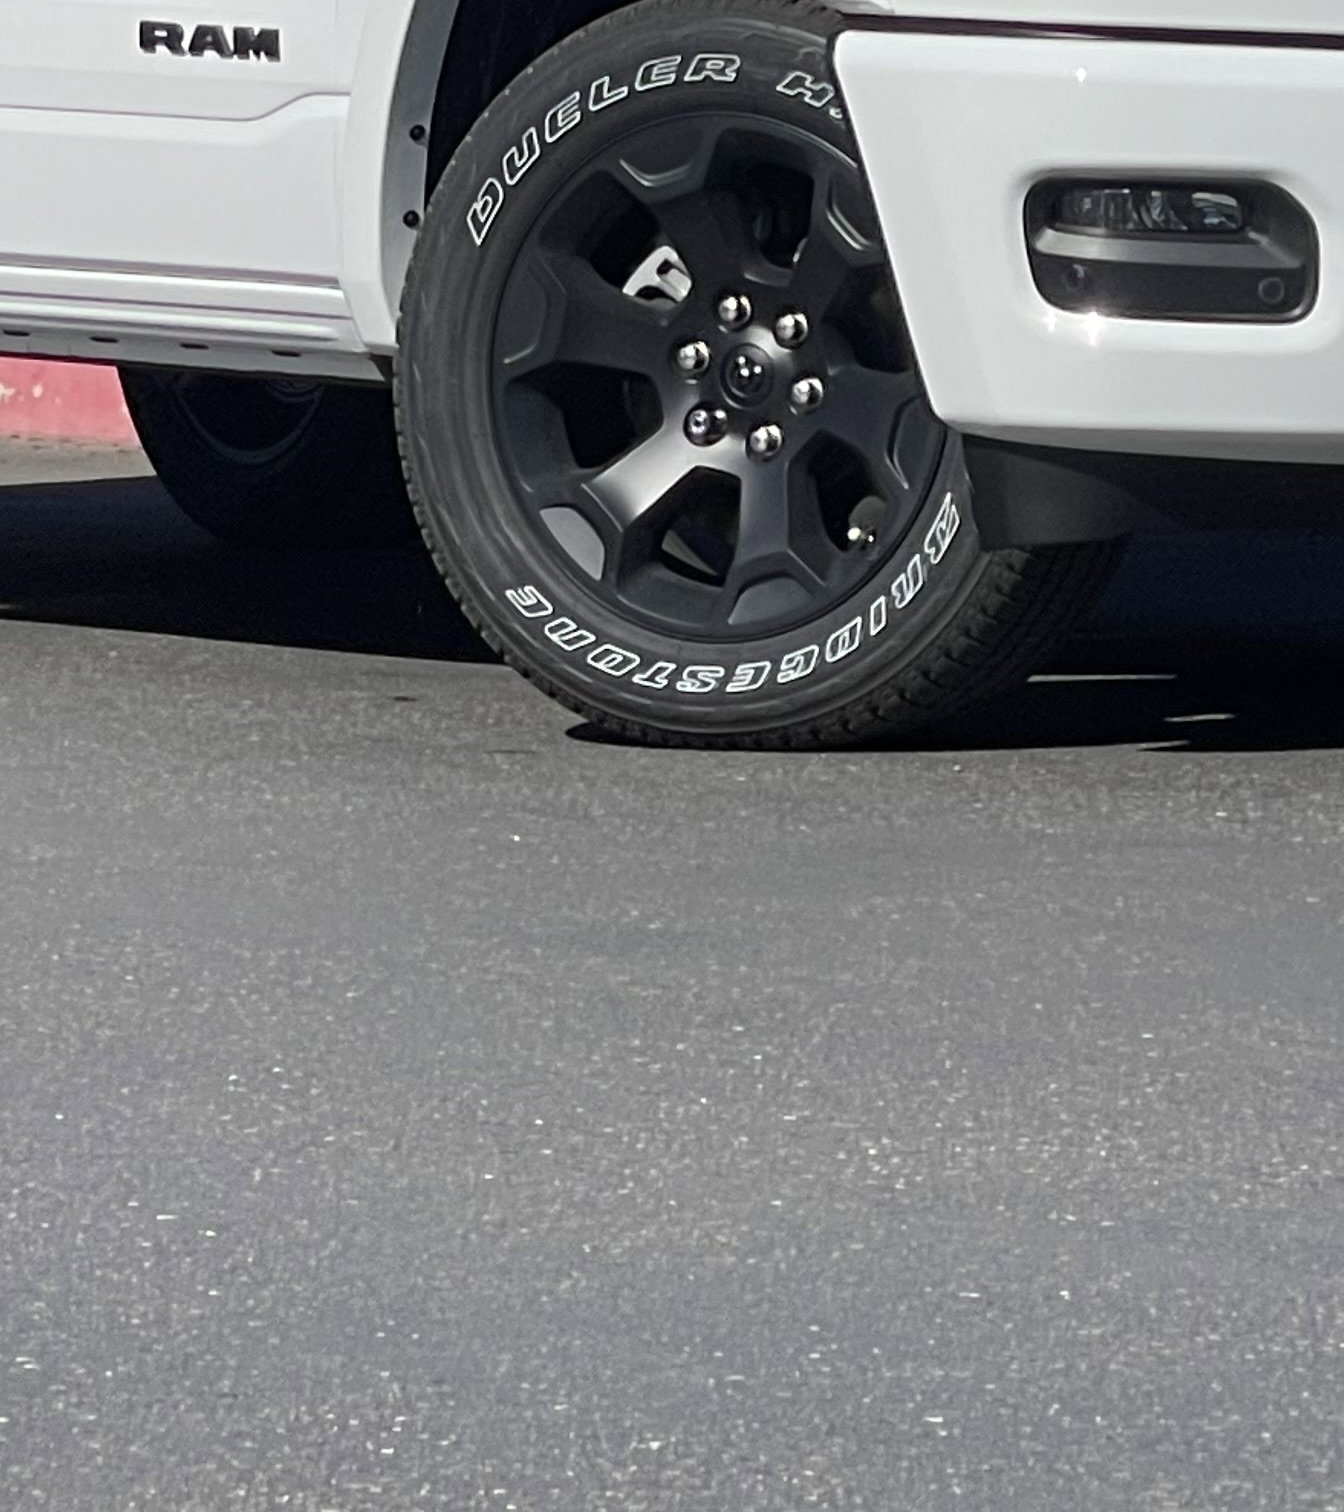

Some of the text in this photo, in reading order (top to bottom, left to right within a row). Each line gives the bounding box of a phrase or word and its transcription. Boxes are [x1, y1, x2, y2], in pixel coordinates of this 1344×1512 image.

[139, 20, 281, 63] RAM
[465, 52, 742, 246] DUELER
[504, 492, 963, 694] BRIDGESTONE
